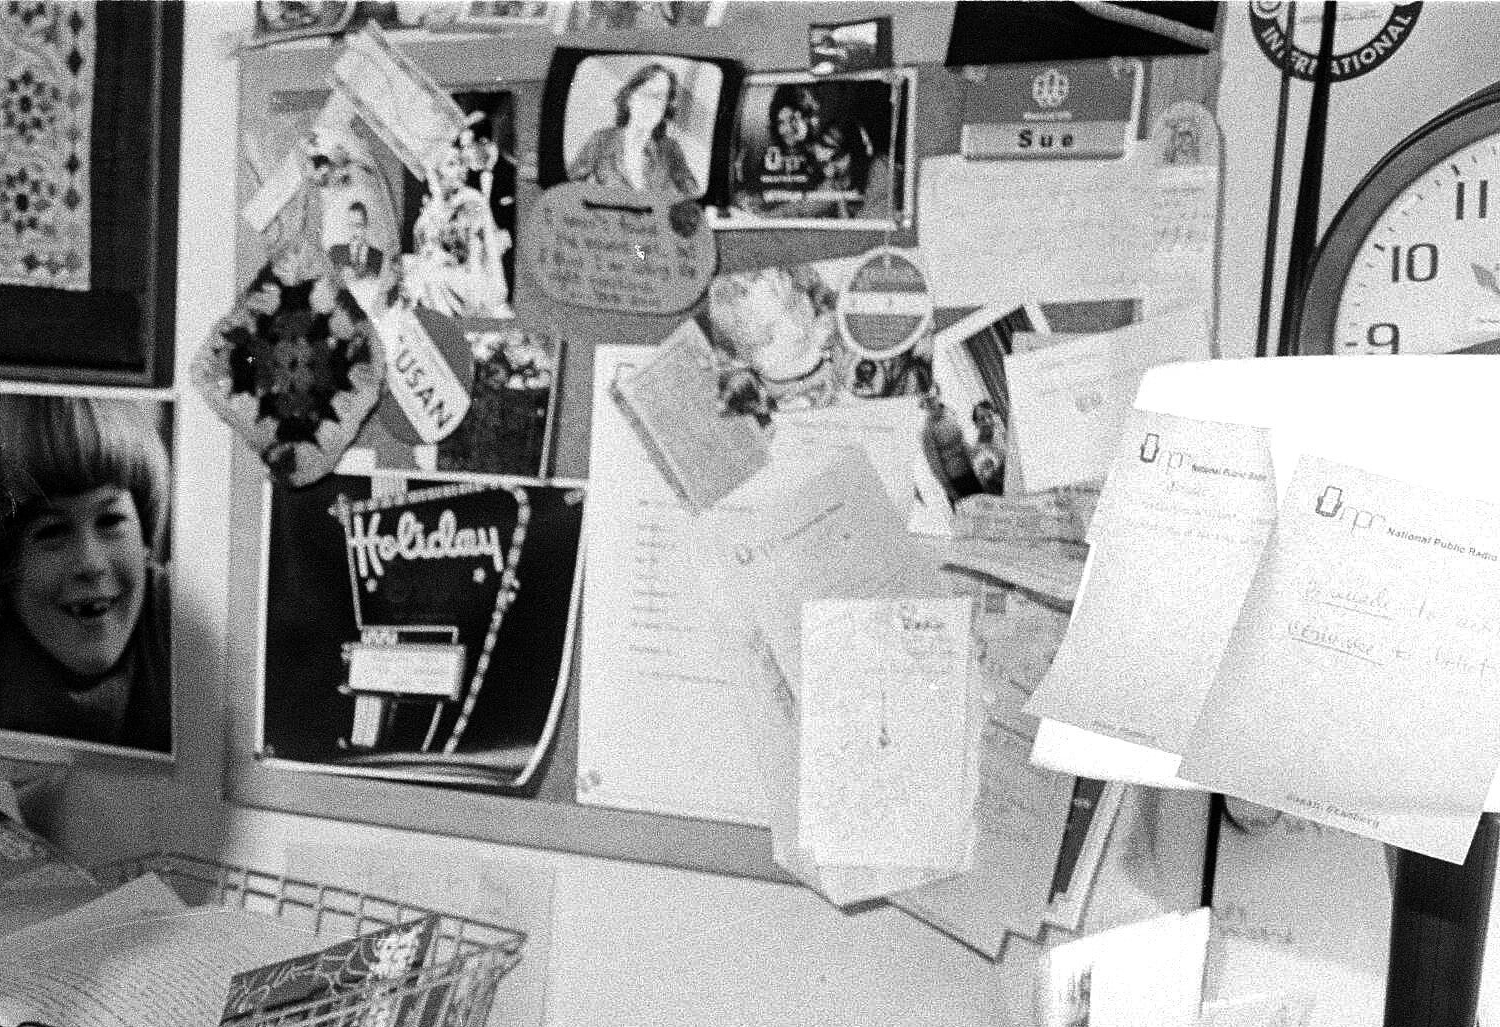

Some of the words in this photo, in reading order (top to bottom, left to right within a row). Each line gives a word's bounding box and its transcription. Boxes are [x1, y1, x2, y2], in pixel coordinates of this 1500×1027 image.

[1018, 129, 1074, 149] Sue
[1455, 179, 1489, 221] 11
[1391, 243, 1439, 283] 10
[1366, 322, 1400, 354] 9
[347, 508, 504, 578] Holiday
[1386, 526, 1431, 545] National
[1433, 538, 1466, 555] Public
[1468, 547, 1499, 563] Radio
